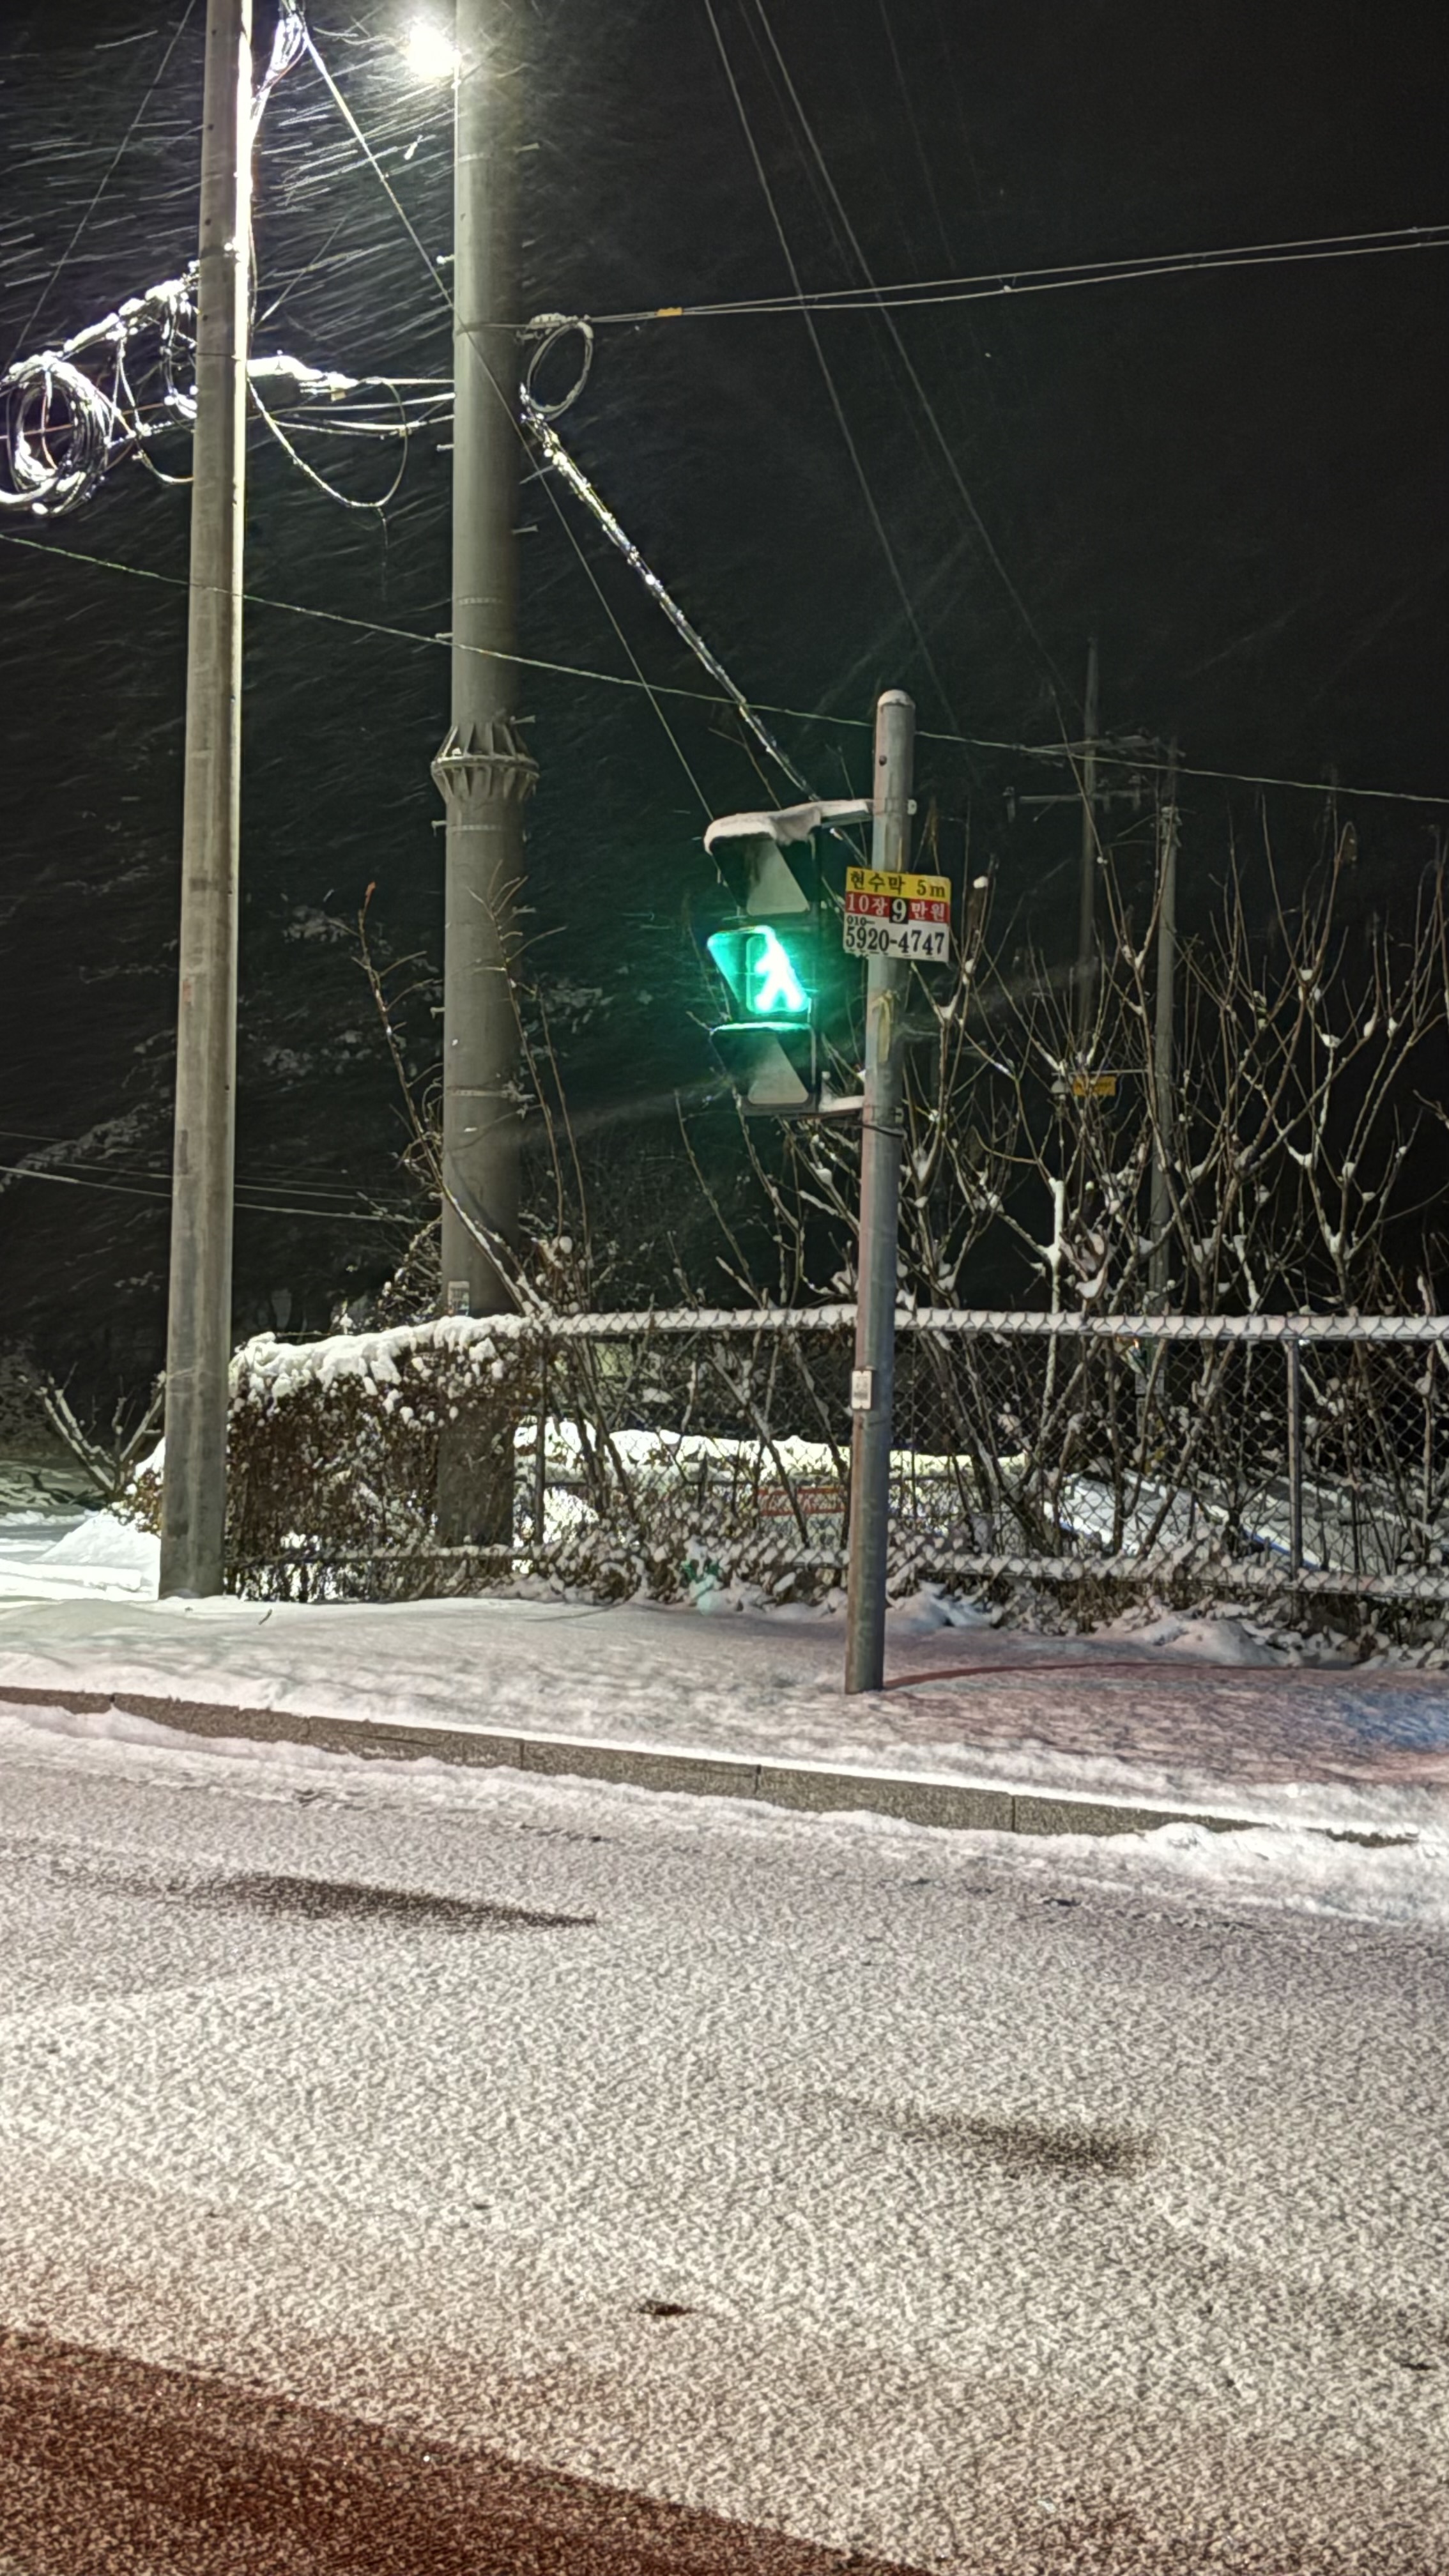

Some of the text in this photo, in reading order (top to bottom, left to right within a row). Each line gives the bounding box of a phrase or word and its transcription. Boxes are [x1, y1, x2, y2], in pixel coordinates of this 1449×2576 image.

[851, 871, 945, 897] 현수막 5m
[846, 926, 945, 955] 5920-4747
